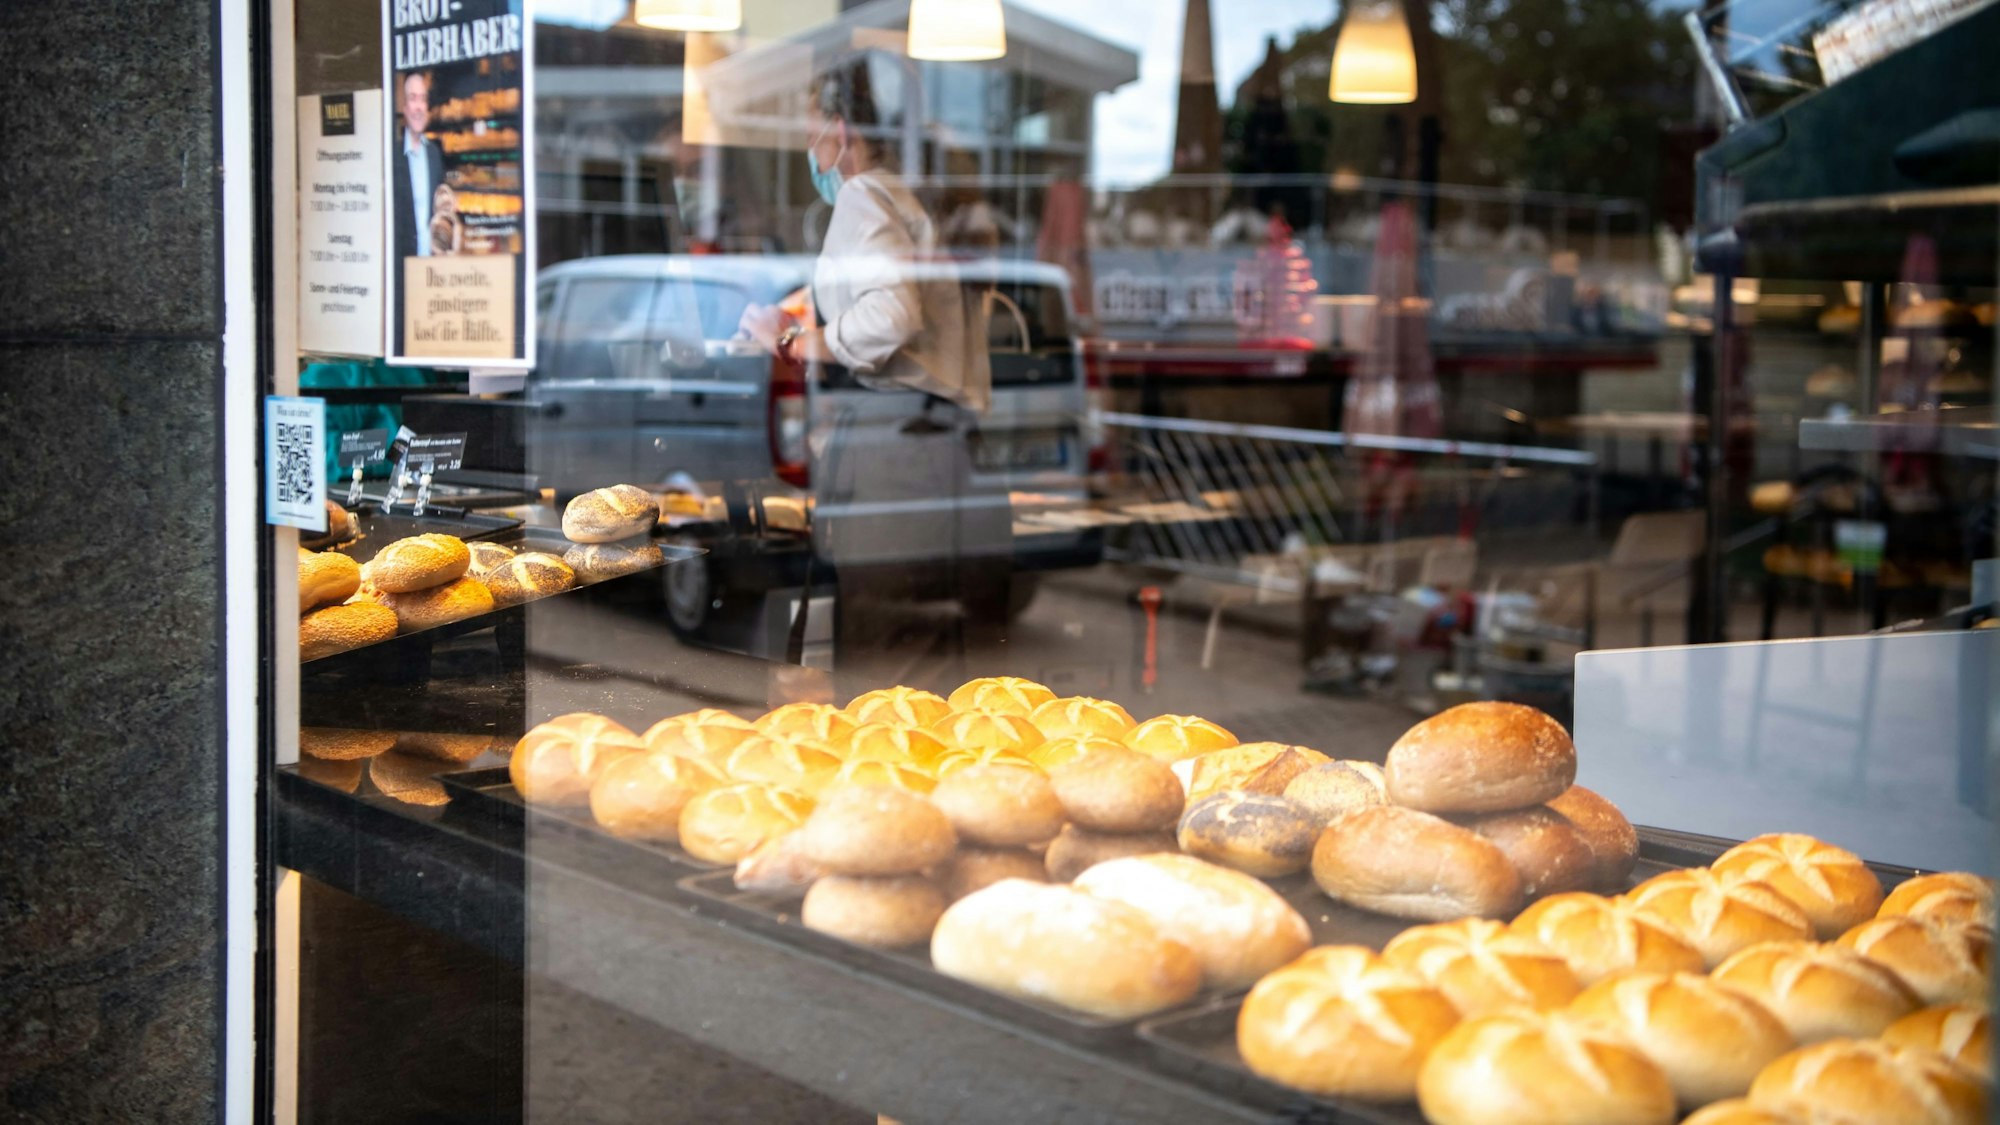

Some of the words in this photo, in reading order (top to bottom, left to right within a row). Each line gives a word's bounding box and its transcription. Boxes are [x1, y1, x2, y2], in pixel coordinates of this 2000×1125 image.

[394, 13, 520, 70] LIEBHABER
[313, 183, 335, 194] Montag
[336, 183, 345, 193] bis
[345, 183, 368, 195] Freitag
[328, 233, 352, 245] Samstag
[426, 266, 445, 288] Das
[427, 293, 489, 319] günstigere
[440, 319, 459, 342] die
